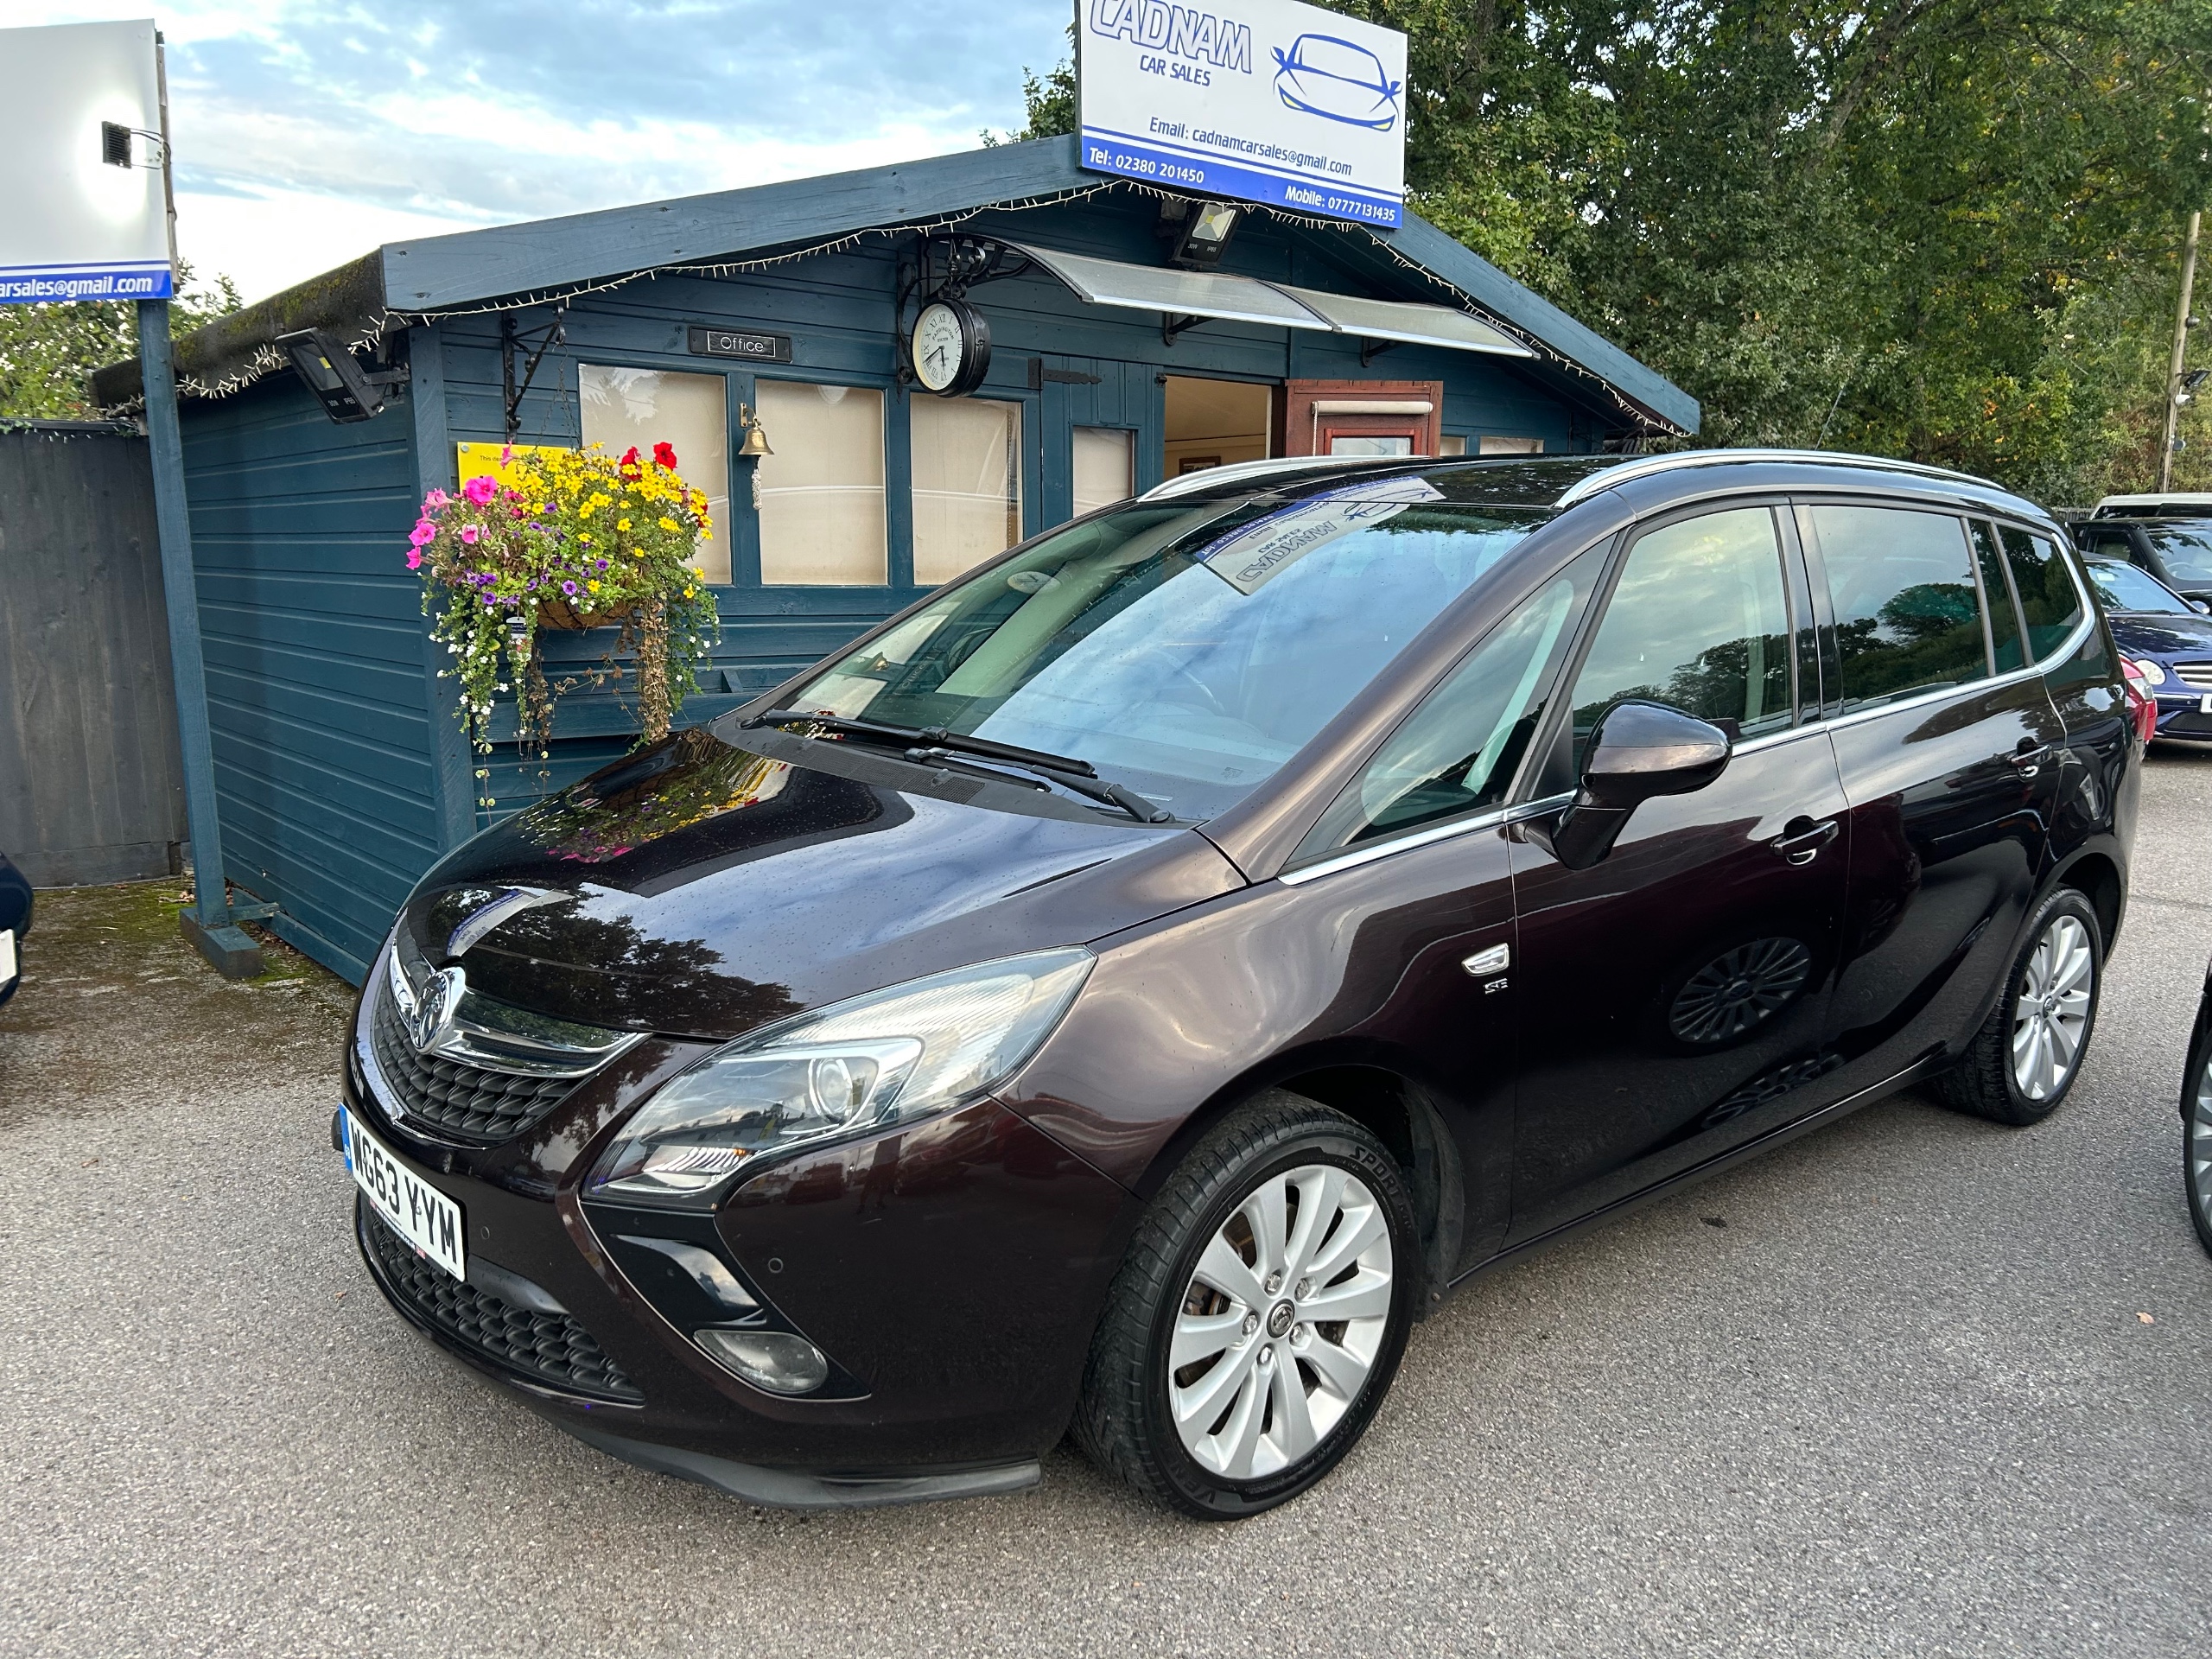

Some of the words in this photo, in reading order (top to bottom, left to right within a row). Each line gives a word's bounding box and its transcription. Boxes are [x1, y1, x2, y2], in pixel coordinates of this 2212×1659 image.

[1090, 0, 1252, 74] CADNAM
[1140, 54, 1166, 76] CAR
[1170, 62, 1211, 86] SALES
[1149, 117, 1189, 139] Email:
[1192, 129, 1352, 175] cadnamcarsales@gmail.com
[1090, 147, 1112, 166] Tel:
[1116, 155, 1156, 174] 02380
[1159, 163, 1205, 183] 201450
[1285, 185, 1325, 207] Mobile:
[1328, 197, 1395, 221] 07777131435
[720, 336, 764, 352] Office
[350, 1121, 400, 1215] WG63
[404, 1174, 458, 1265] YYM
